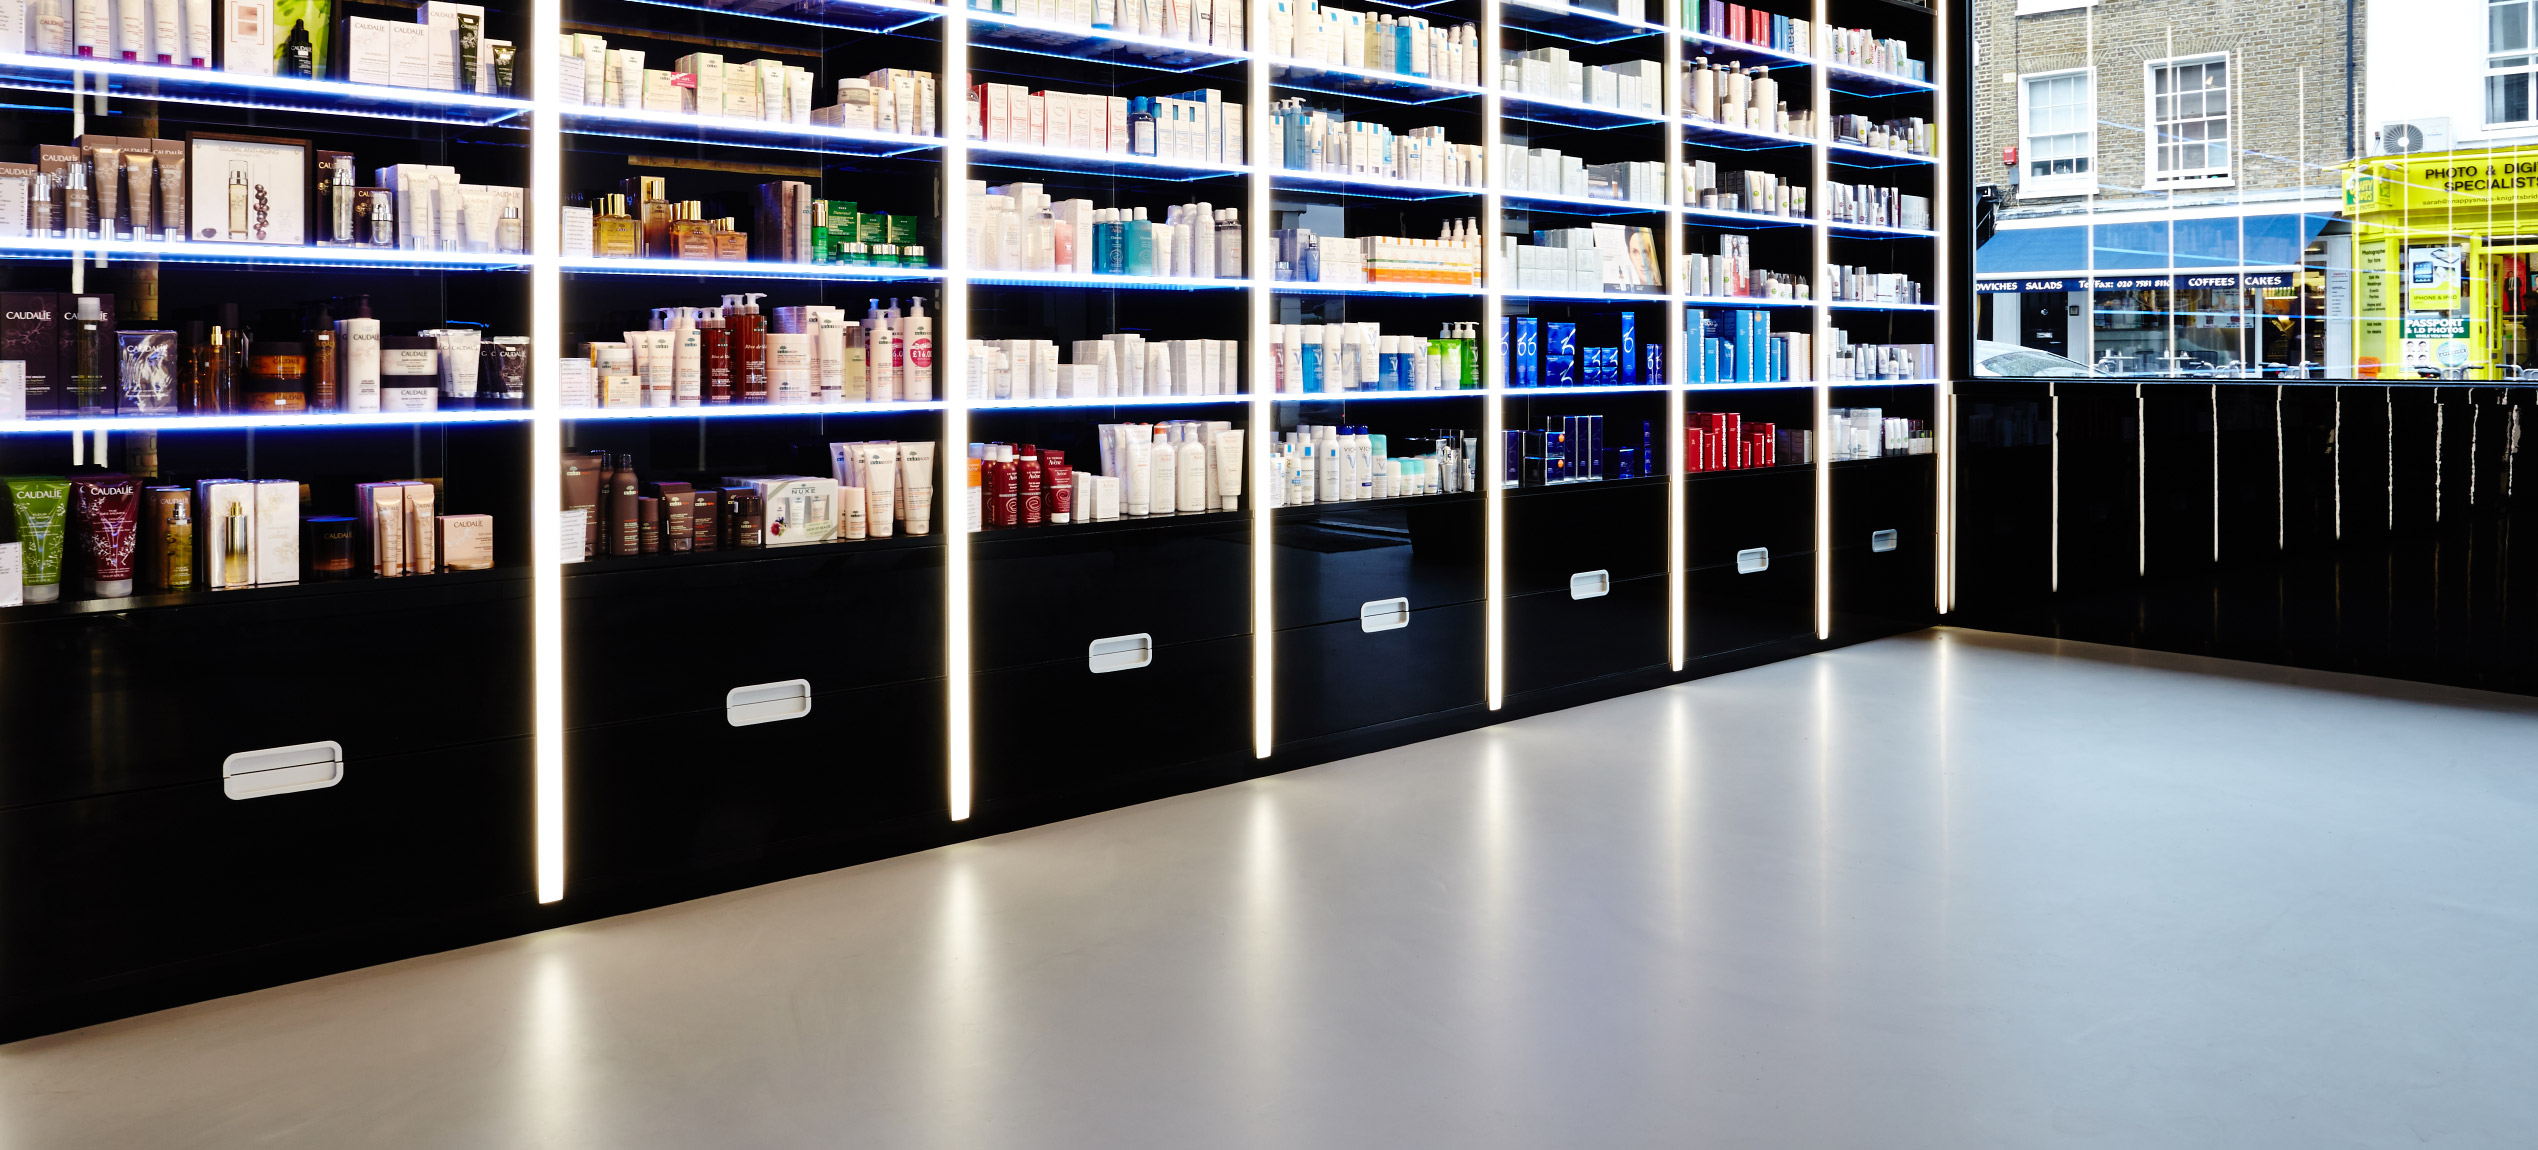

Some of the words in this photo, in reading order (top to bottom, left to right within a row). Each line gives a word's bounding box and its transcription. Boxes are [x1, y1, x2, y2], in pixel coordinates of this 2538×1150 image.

[2426, 166, 2477, 180] PHOTO
[2486, 165, 2496, 176] &
[2505, 162, 2538, 174] DIGI
[2444, 176, 2538, 192] SPECIALIST
[2025, 281, 2063, 290] SALADS
[2188, 277, 2236, 287] COFFEES
[2245, 276, 2282, 286] CAKES
[2406, 318, 2464, 327] PASSPORT
